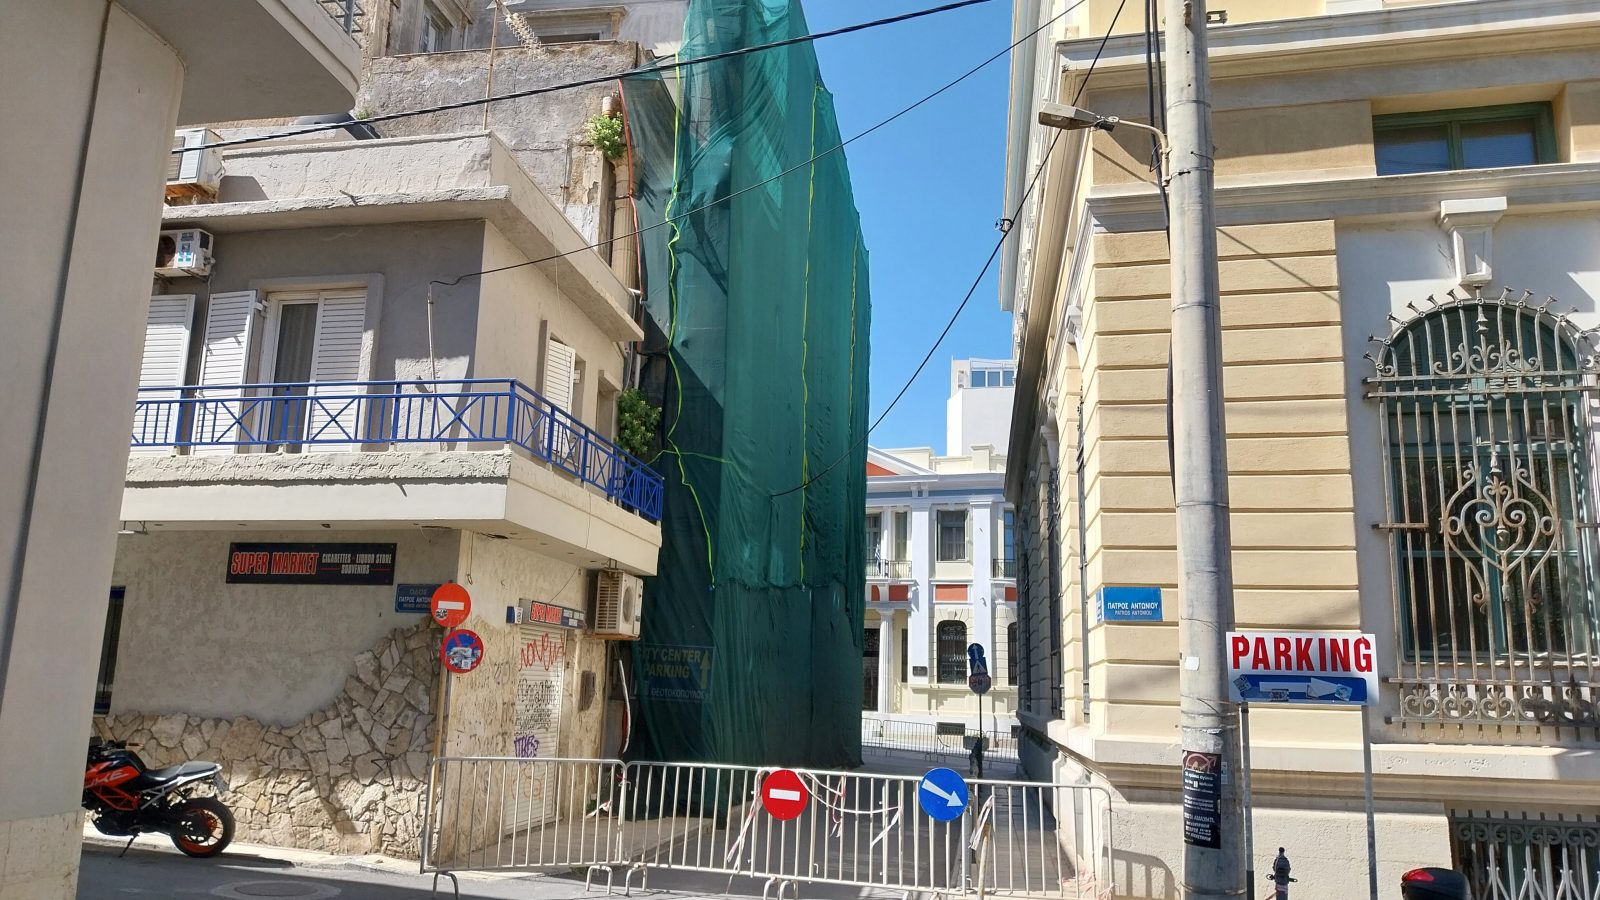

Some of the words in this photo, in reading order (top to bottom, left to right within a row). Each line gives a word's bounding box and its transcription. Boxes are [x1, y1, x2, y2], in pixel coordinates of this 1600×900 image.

[231, 551, 269, 575] SUPER
[271, 552, 319, 575] MARKET
[375, 554, 392, 564] STORE
[1107, 602, 1129, 610] ΠΑΤΡΟΣ
[1130, 602, 1159, 610] ΑΝΤΩΝΙΟΥ
[661, 647, 701, 663] CENTER
[1231, 636, 1373, 673] PARKING
[643, 663, 690, 678] PARKING
